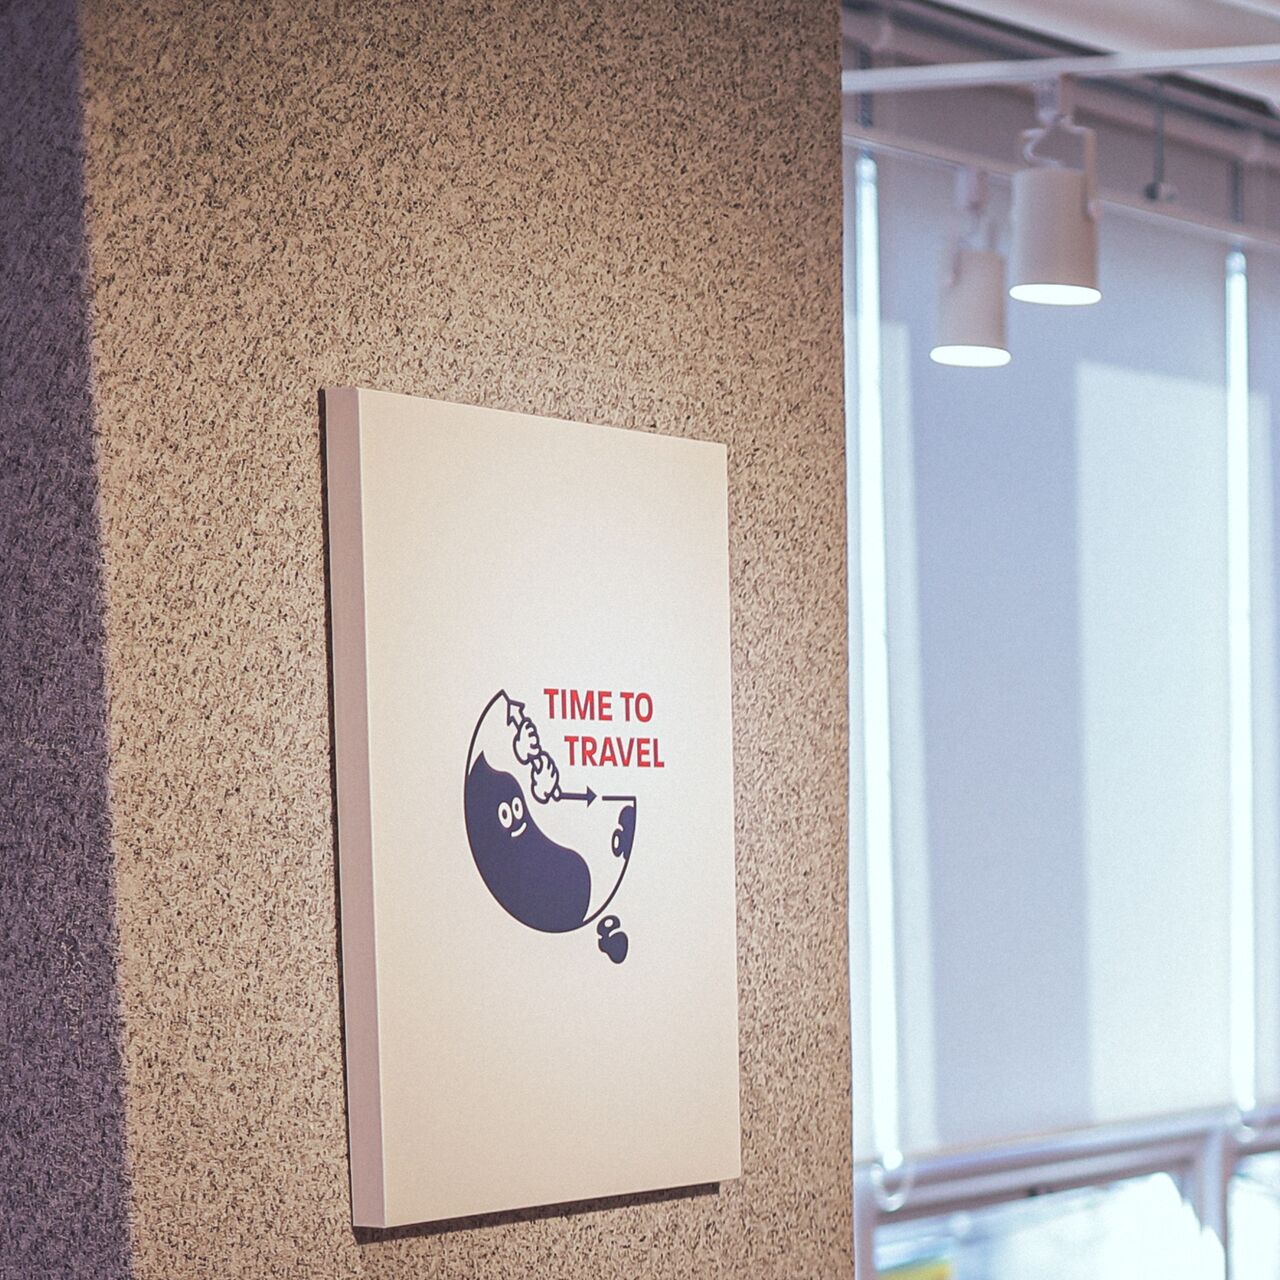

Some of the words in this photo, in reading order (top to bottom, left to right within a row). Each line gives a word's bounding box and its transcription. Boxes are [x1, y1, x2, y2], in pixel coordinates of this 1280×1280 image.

[543, 688, 613, 721] TIME
[620, 691, 654, 723] TO
[564, 735, 665, 768] TRAVEL
